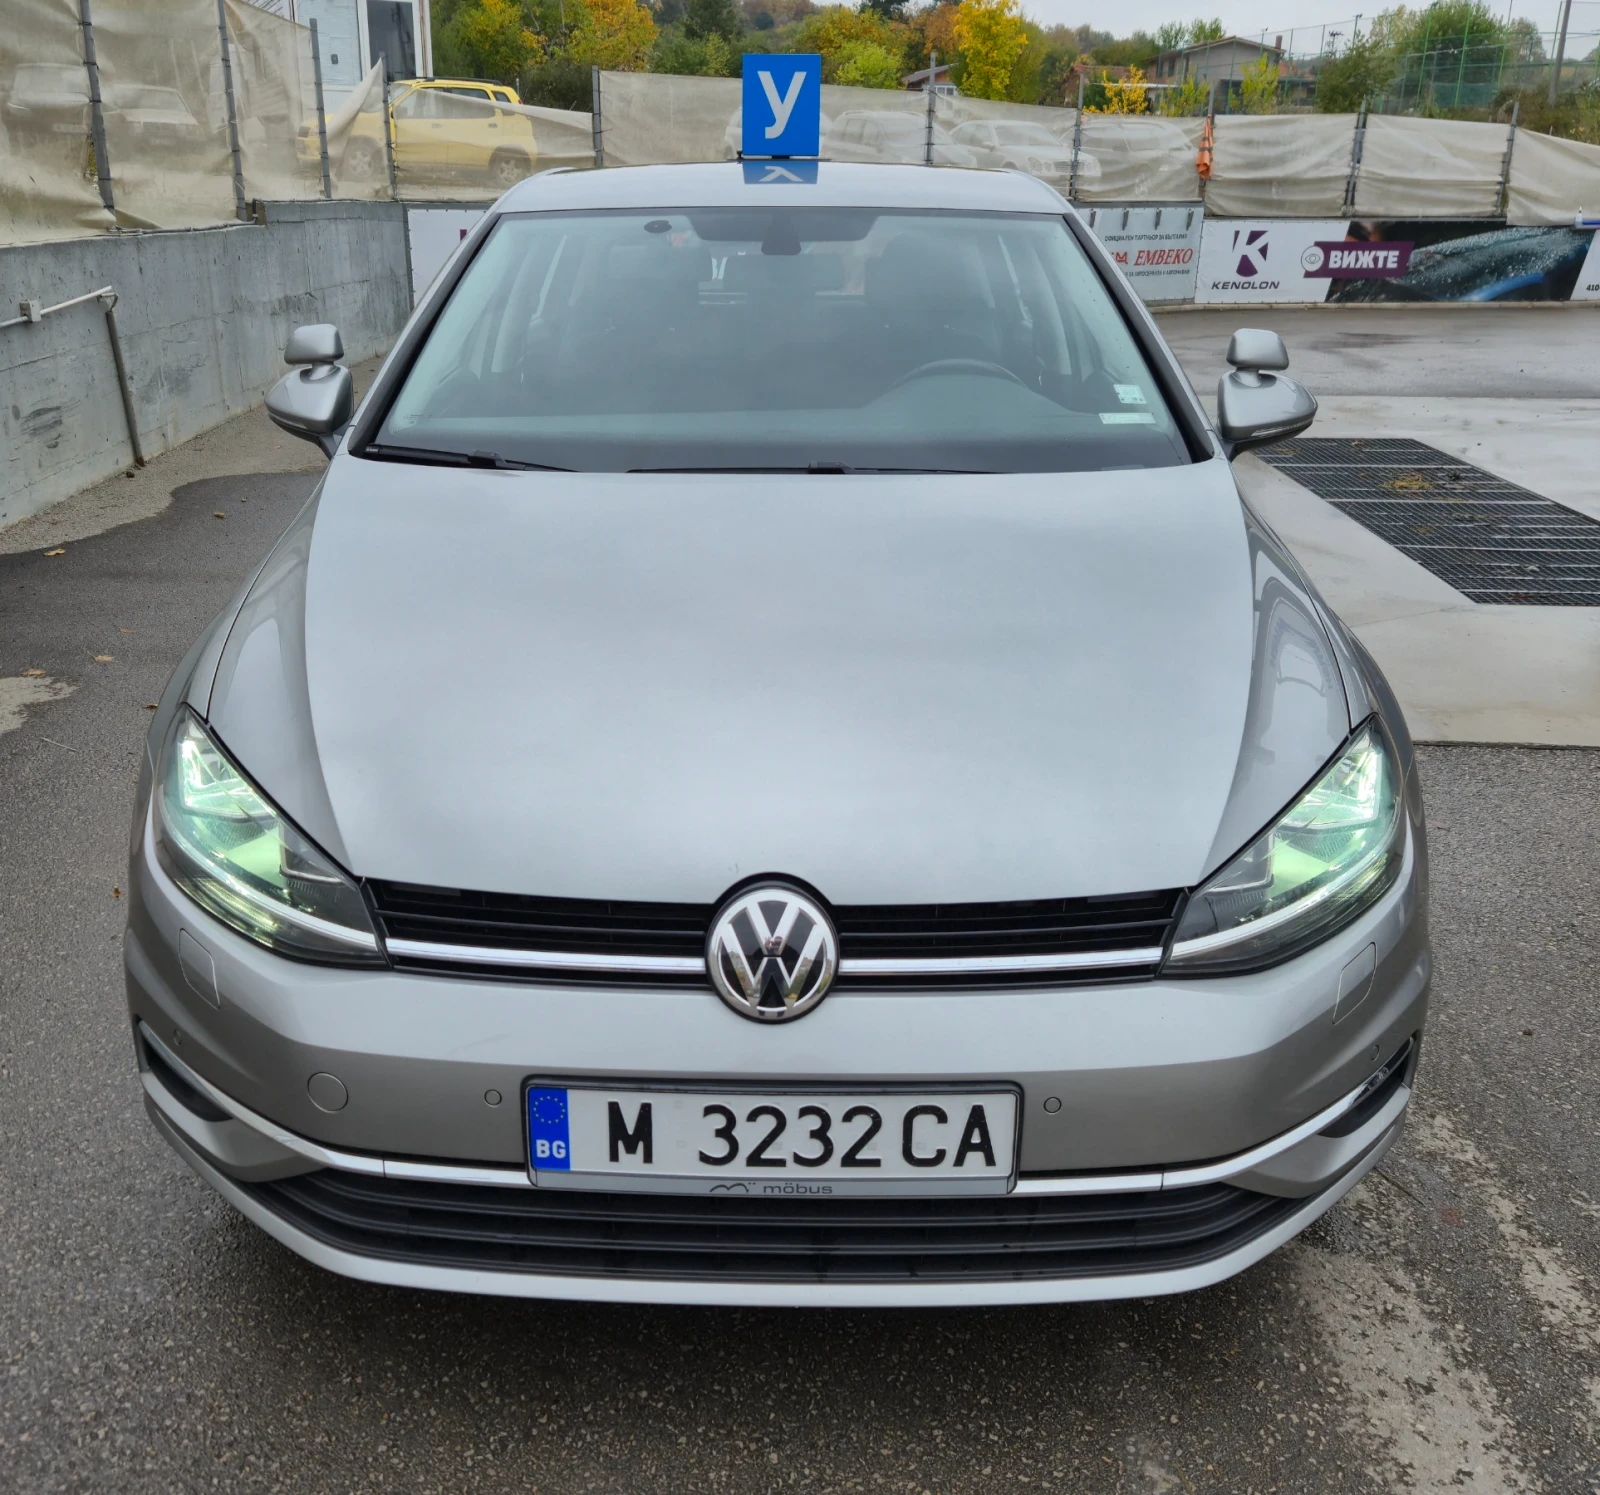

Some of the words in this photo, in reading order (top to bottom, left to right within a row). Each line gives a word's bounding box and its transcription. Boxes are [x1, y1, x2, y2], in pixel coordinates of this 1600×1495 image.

[1328, 250, 1400, 269] ВИЖТЕ
[1211, 281, 1281, 290] KENOLON
[607, 1101, 654, 1164] M
[698, 1104, 882, 1168] 3232
[536, 1139, 567, 1159] BG
[763, 1181, 833, 1195] möbus
